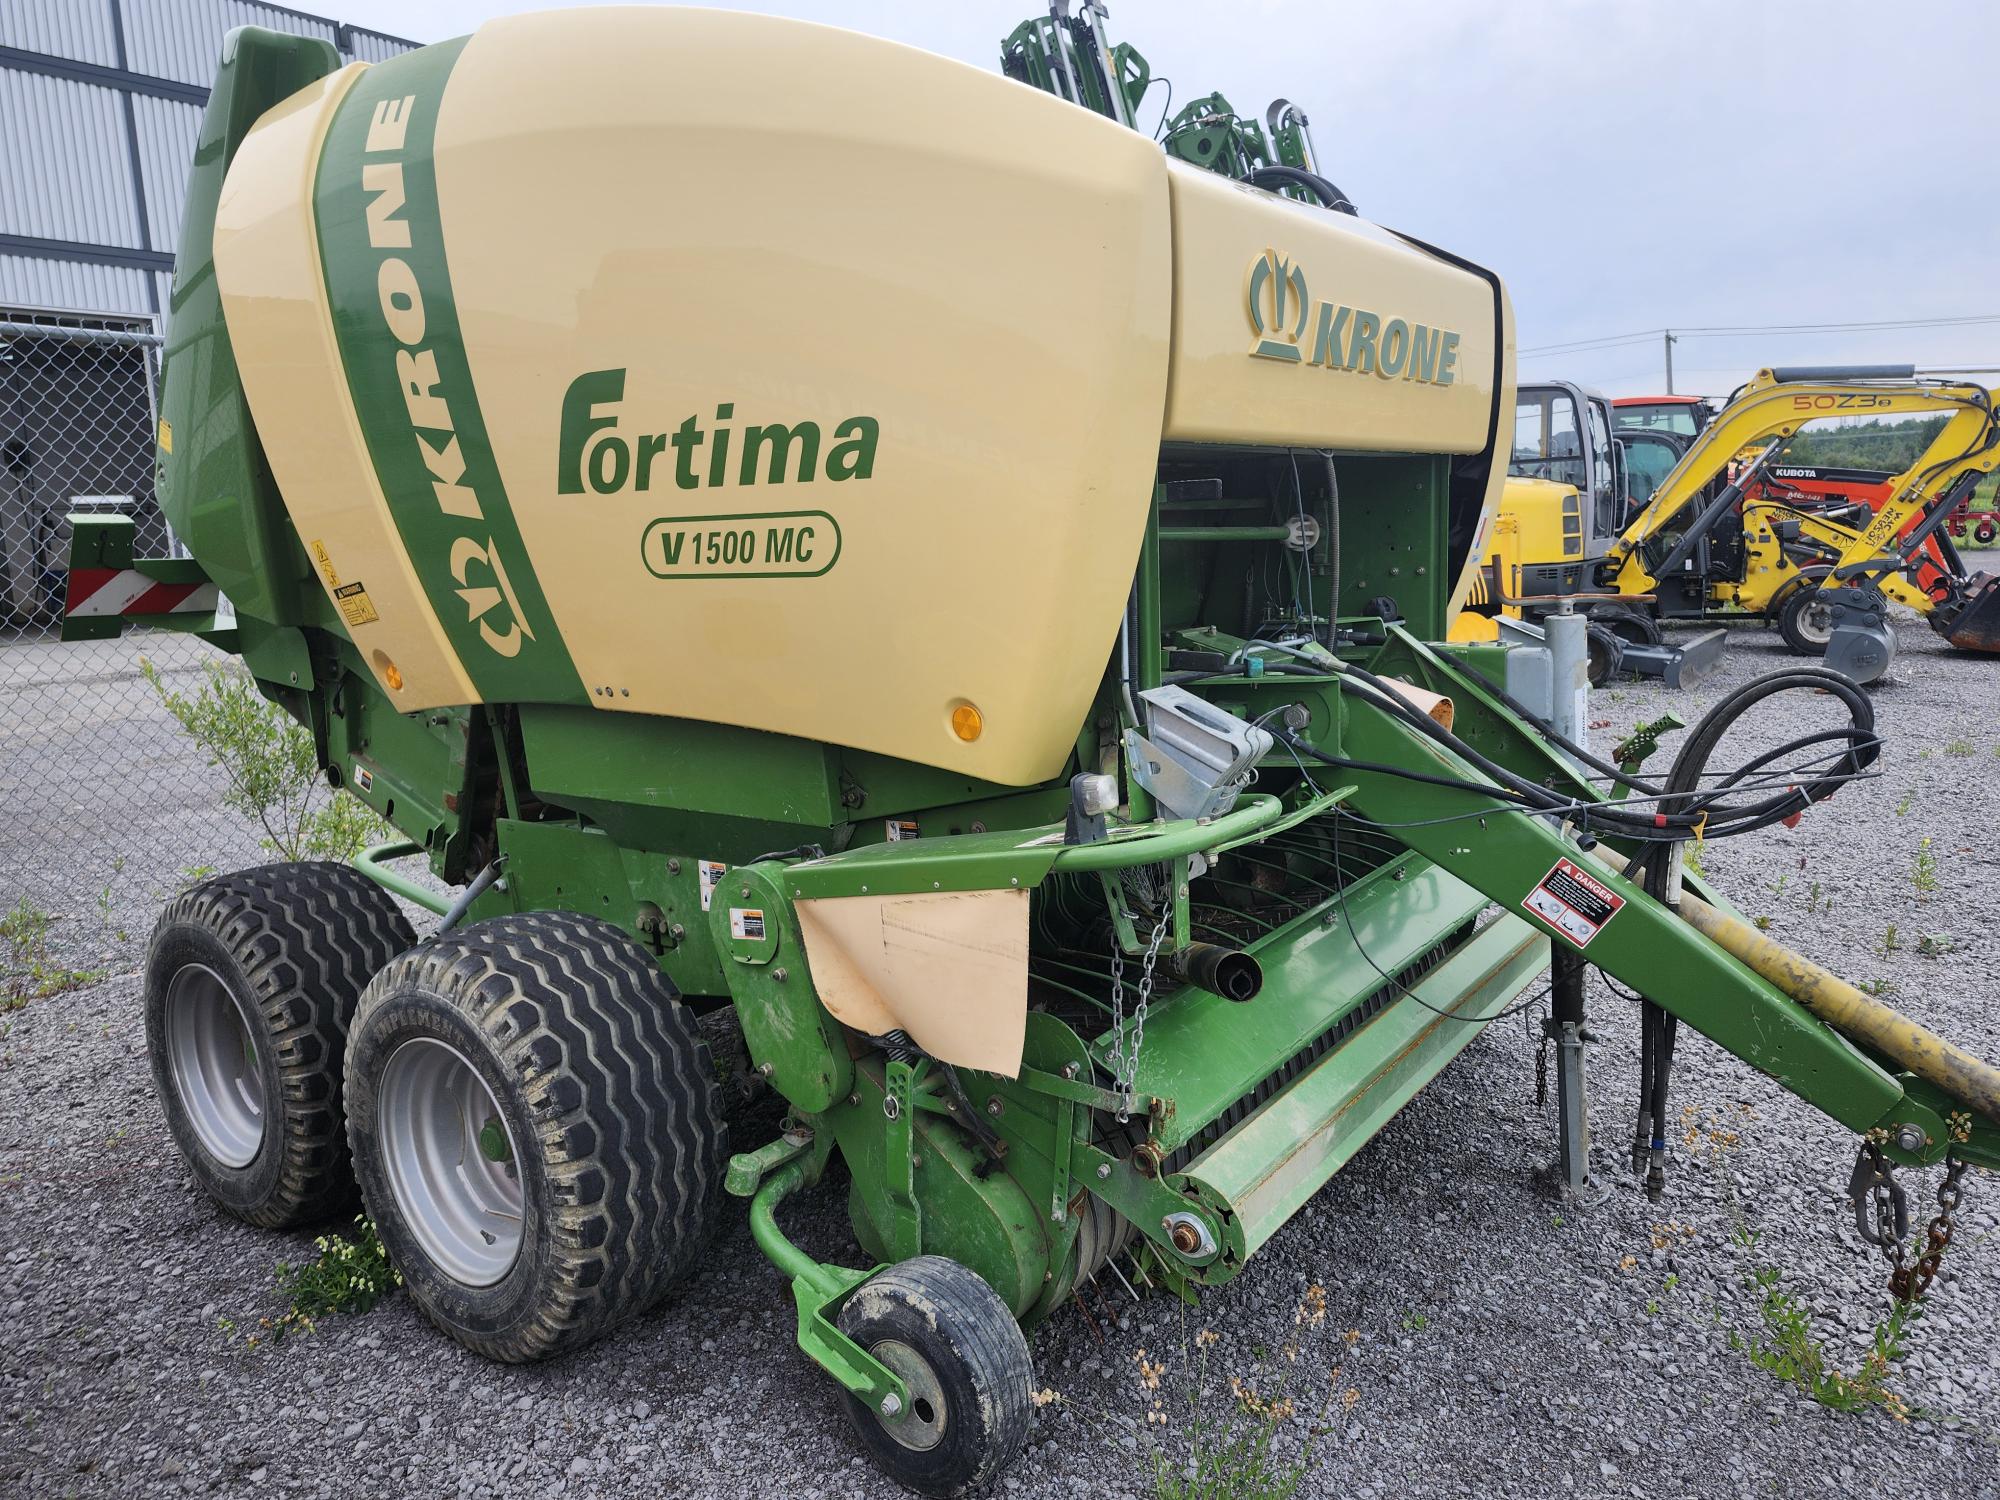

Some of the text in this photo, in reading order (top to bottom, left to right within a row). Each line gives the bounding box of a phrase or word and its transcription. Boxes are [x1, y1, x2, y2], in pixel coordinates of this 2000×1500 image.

[362, 95, 485, 520] KRONE
[1308, 300, 1461, 387] KRONE
[557, 367, 880, 495] Fortima
[1775, 468, 1816, 478] KUBOTA
[765, 527, 815, 563] MC
[1574, 872, 1613, 902] DANGER
